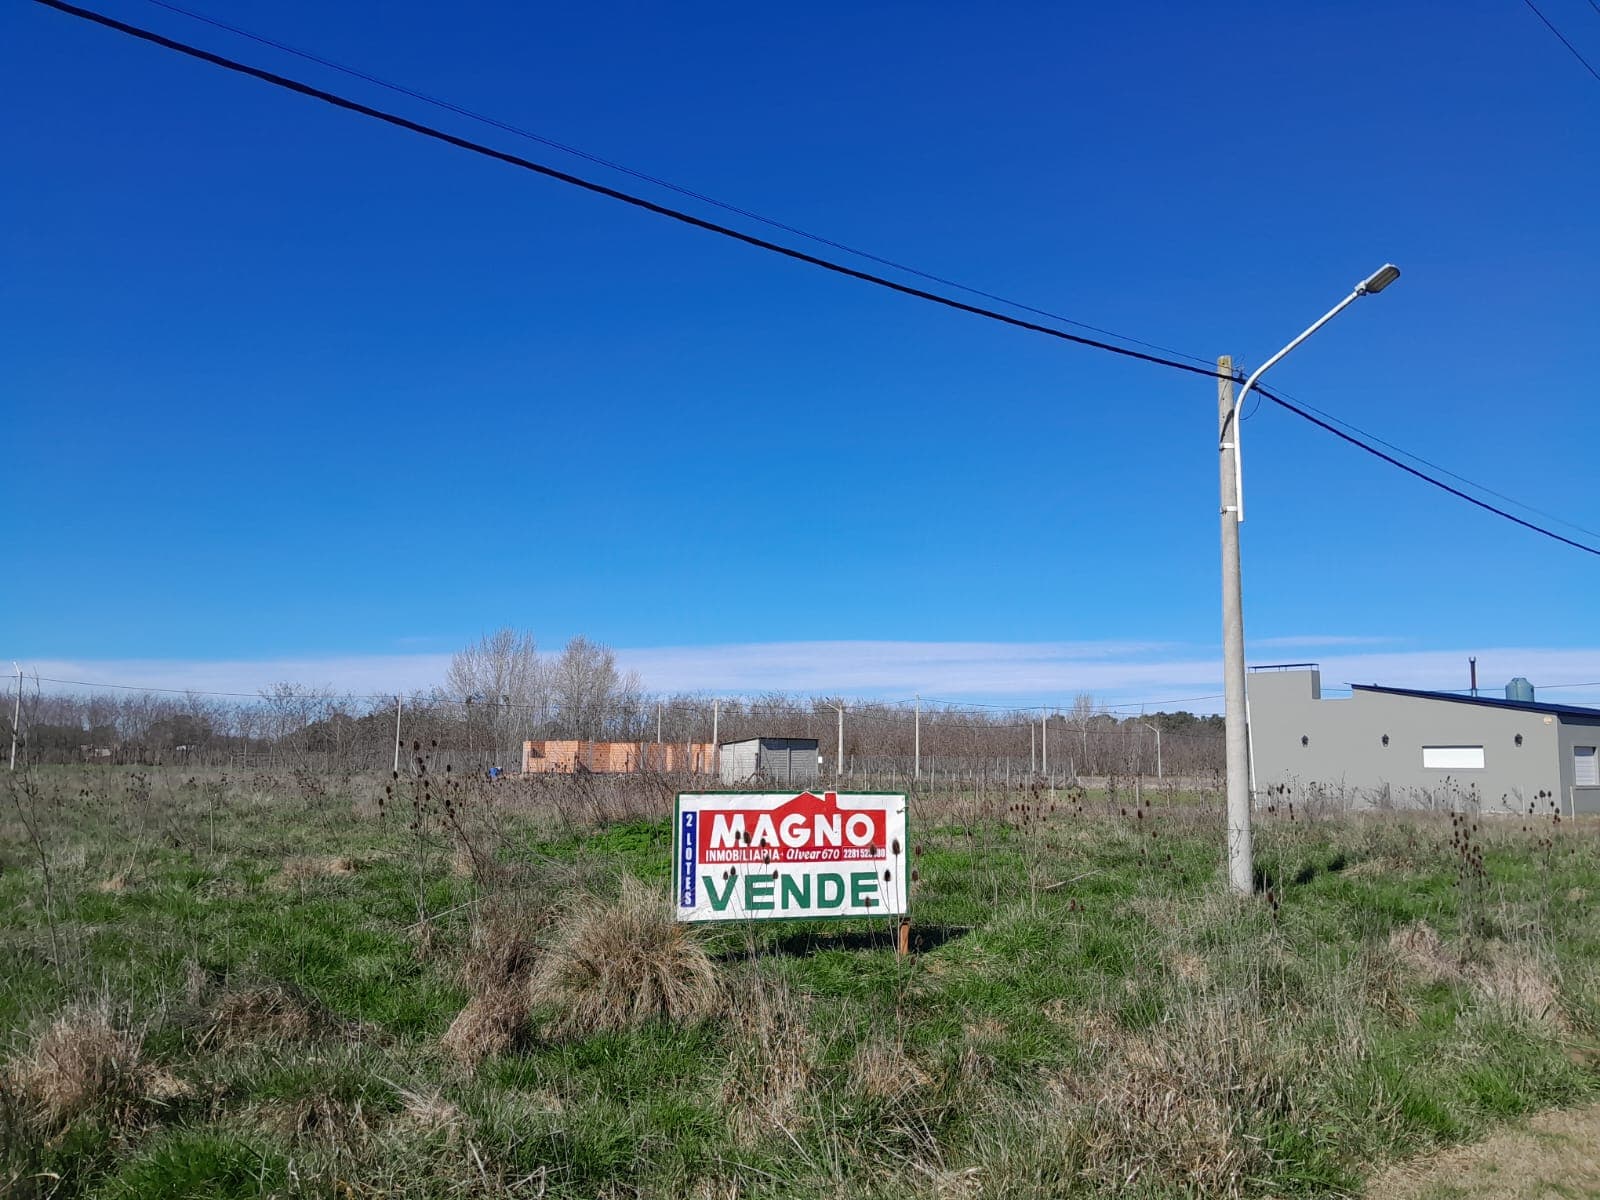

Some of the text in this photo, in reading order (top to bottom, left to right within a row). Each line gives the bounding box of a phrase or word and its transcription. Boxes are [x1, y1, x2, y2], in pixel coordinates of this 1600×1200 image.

[709, 813, 875, 849] MAGNO
[684, 814, 693, 905] 2 LOTES
[705, 849, 780, 862] INMOBILIARIA
[822, 848, 840, 860] 670
[701, 871, 880, 912] VENDE
